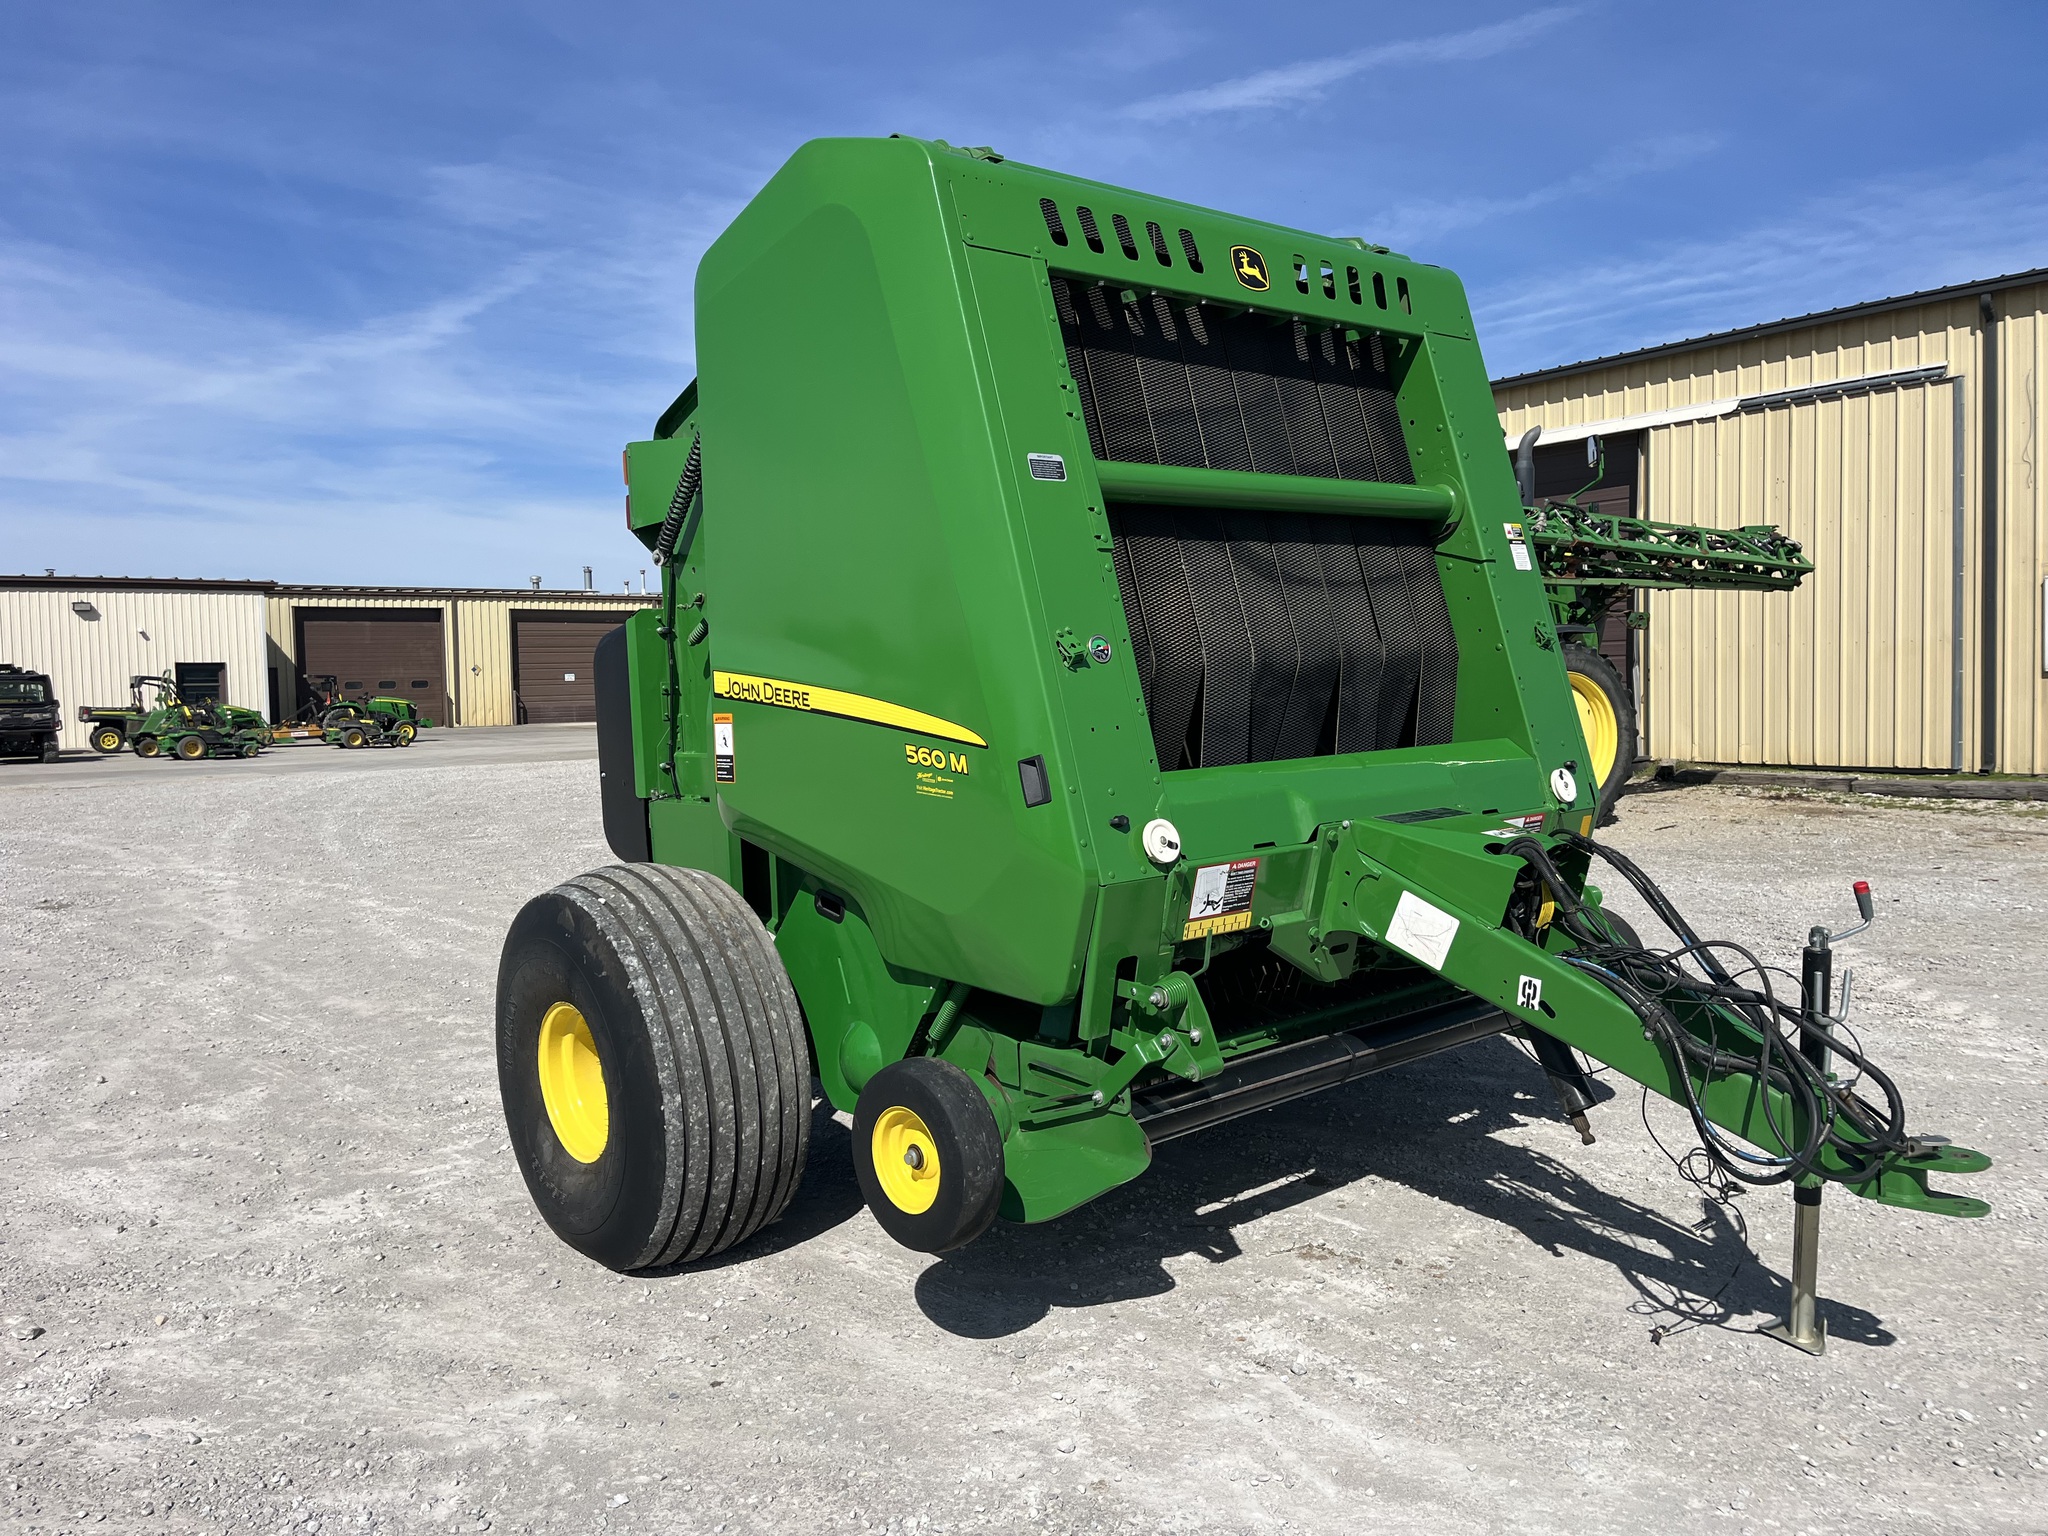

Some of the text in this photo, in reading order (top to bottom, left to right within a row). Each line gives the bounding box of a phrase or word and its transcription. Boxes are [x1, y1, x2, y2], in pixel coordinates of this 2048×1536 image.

[724, 677, 811, 708] JOHN DEERE
[905, 744, 969, 776] 560 M
[1237, 860, 1257, 869] DANGER
